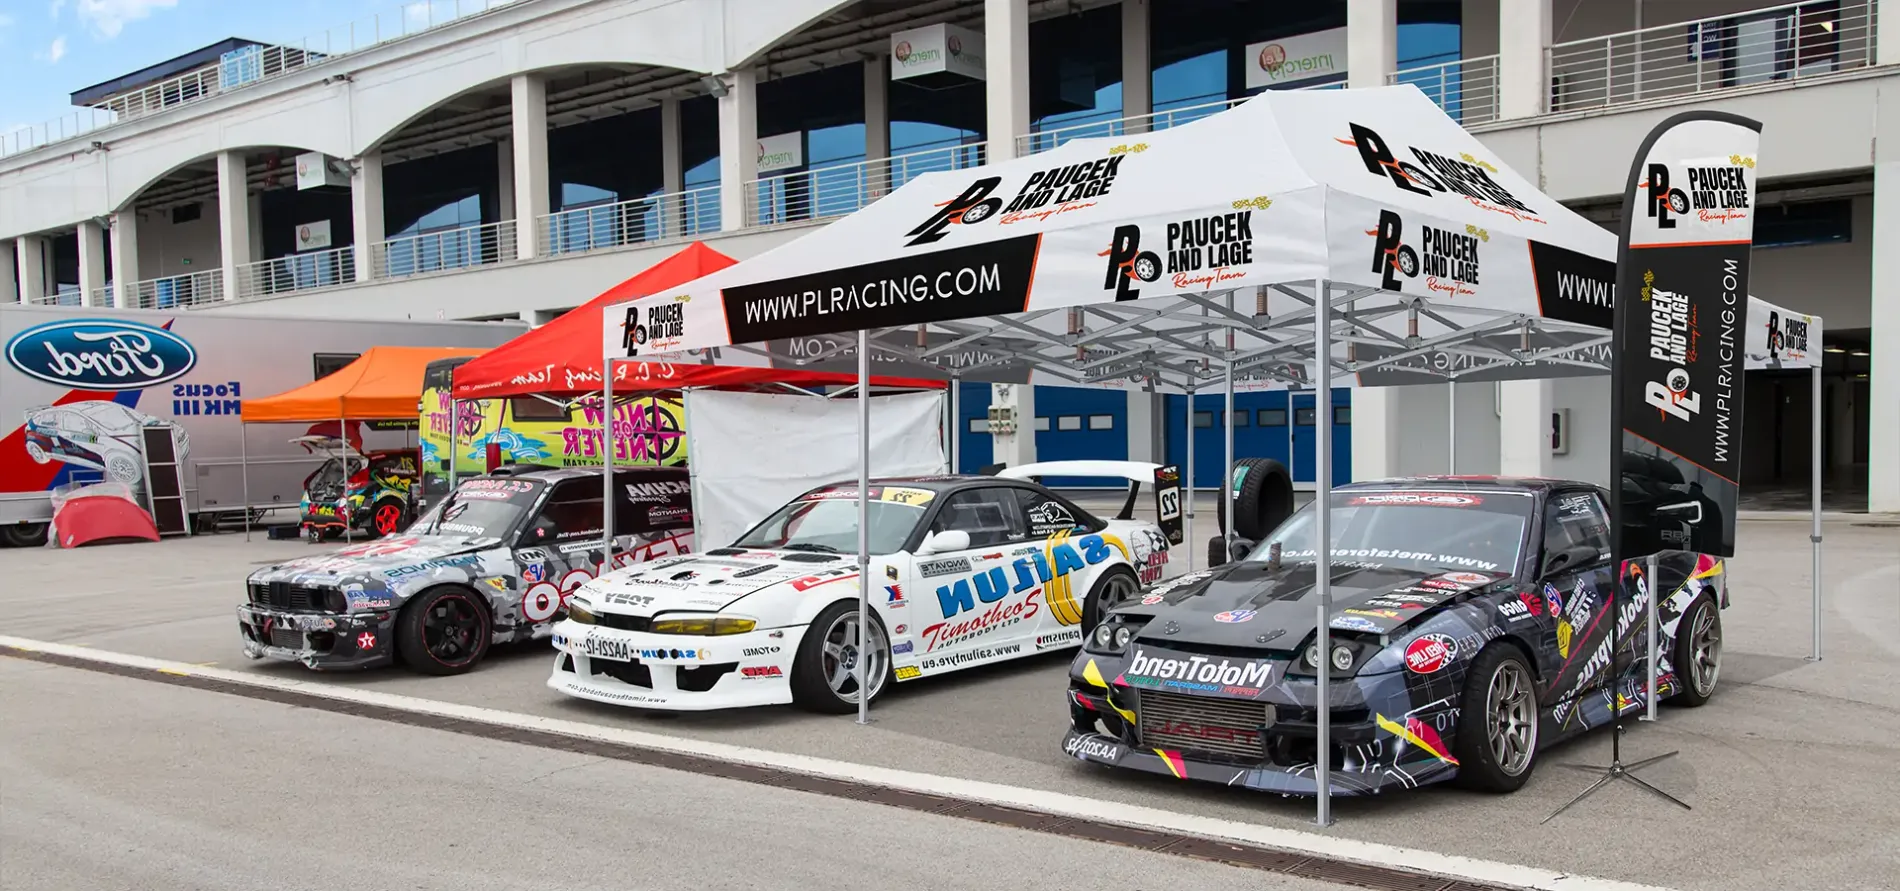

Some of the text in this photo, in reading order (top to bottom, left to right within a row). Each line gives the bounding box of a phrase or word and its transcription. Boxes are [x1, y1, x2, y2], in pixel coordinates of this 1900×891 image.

[1018, 155, 1125, 195] PAUCEK
[1688, 168, 1747, 190] PAUCEK
[1001, 176, 1114, 215] AND LAGE
[1693, 190, 1749, 209] AND LAGE
[999, 201, 1097, 226] Racing Team
[1698, 208, 1746, 224] Racing Team
[1167, 211, 1252, 250] PAUCEK
[1422, 225, 1479, 264] PAUCEK
[1167, 241, 1252, 273] AND LAGE
[1423, 253, 1480, 285] AND LAGE
[745, 263, 1000, 324] WWW.PLRACING.COM
[1172, 267, 1246, 289] Racing Team
[1426, 276, 1475, 298] Racing Team
[649, 303, 683, 325] PAUCEK
[1651, 288, 1672, 361] PAUCEK
[1669, 293, 1688, 365] AND LAGE
[649, 322, 683, 340] AND LAGE
[1715, 259, 1738, 462] WWW.PLRACING.COM
[937, 617, 1020, 650] AUTOBODY LTD
